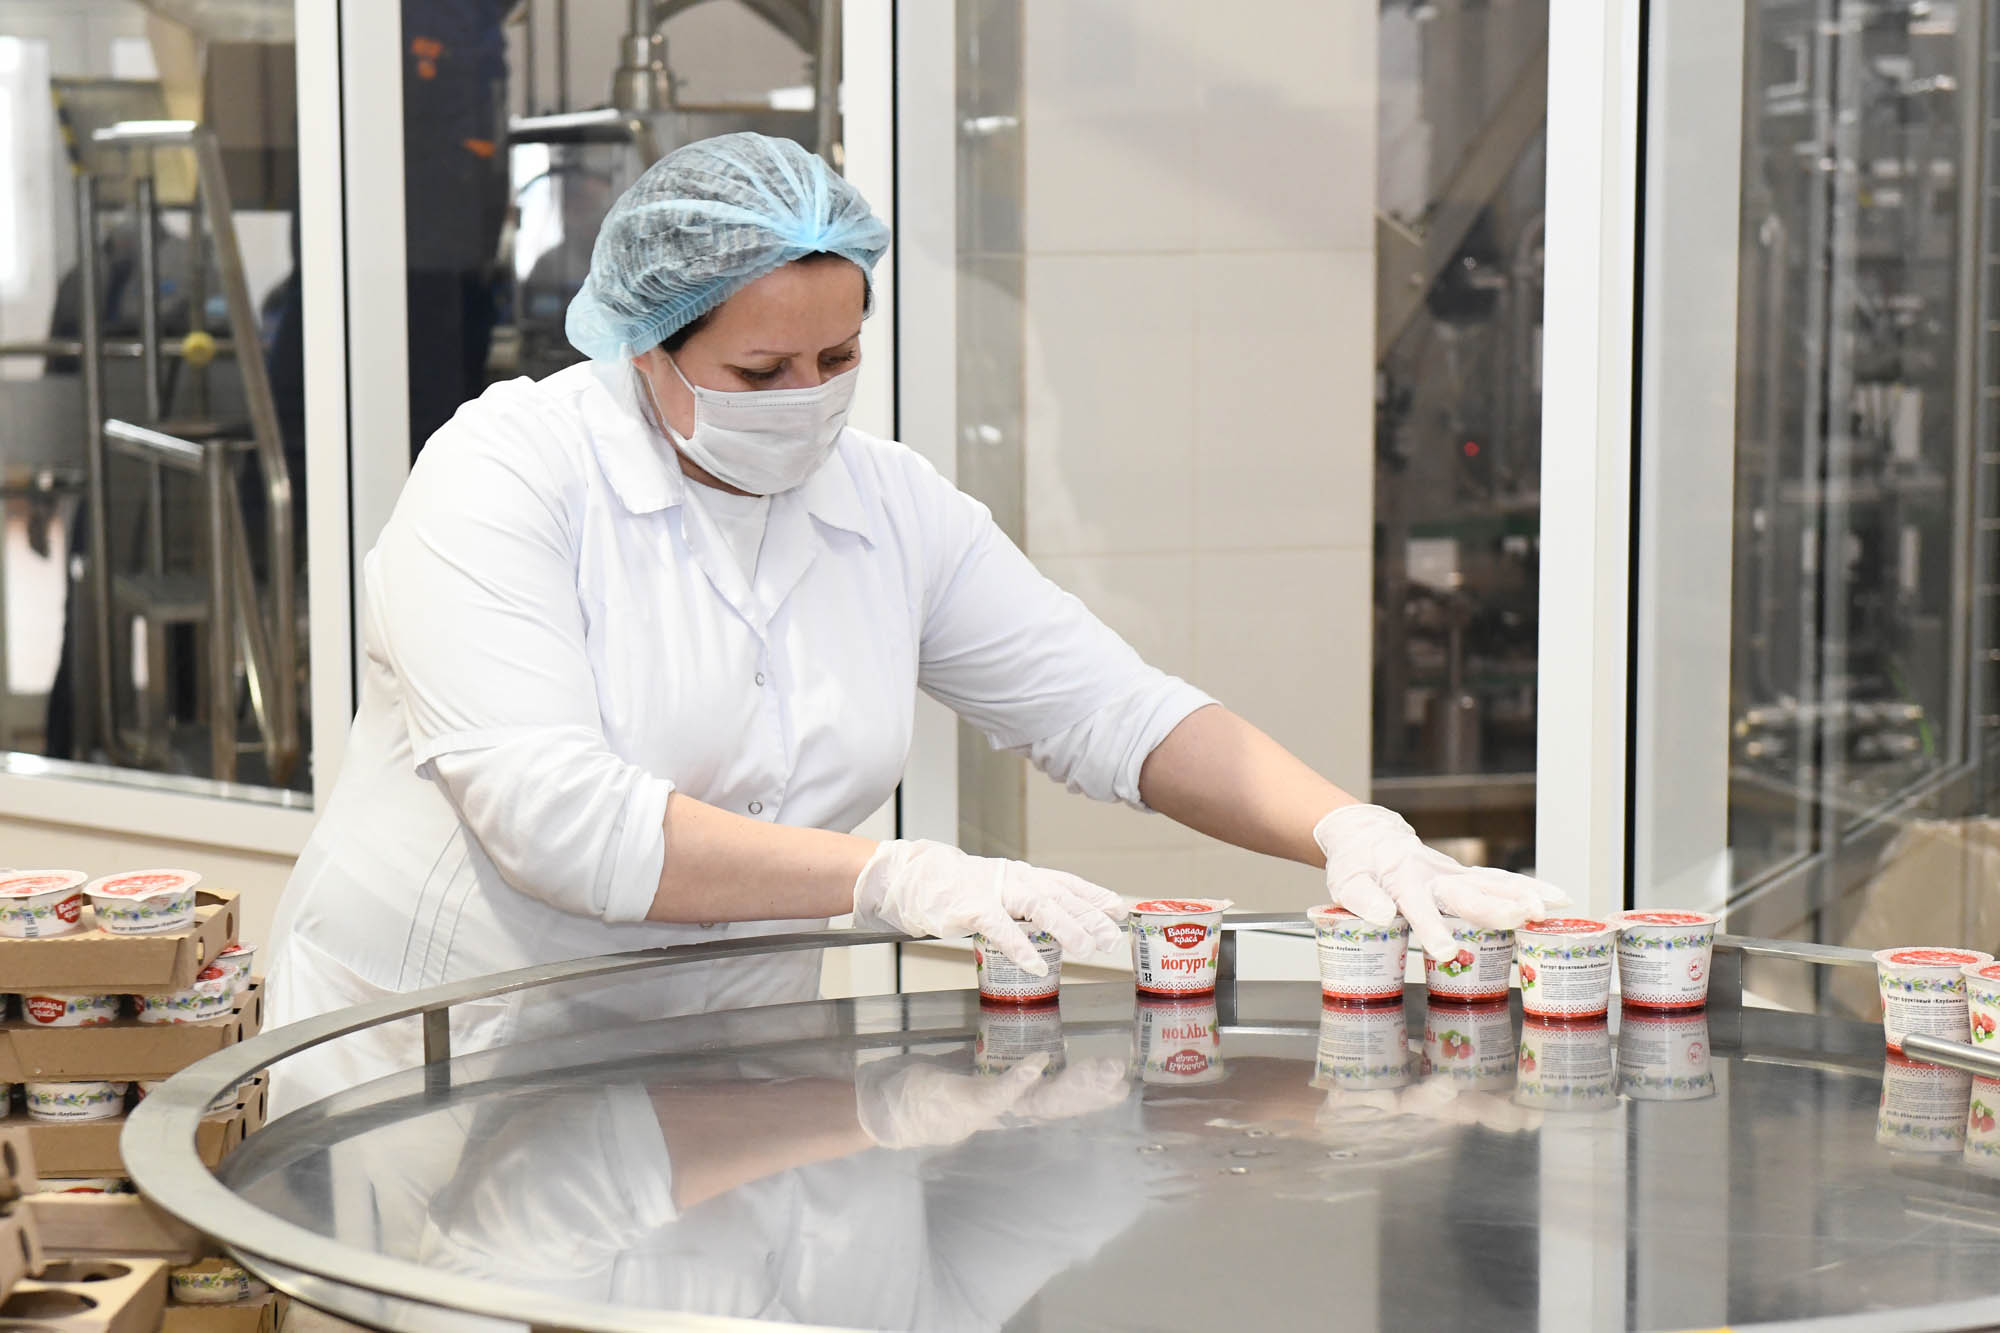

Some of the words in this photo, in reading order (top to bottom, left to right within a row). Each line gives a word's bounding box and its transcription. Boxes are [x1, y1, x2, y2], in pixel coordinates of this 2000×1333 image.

[1167, 927, 1204, 938] Варвара
[1174, 936, 1198, 945] краса
[1161, 954, 1207, 974] йогурт
